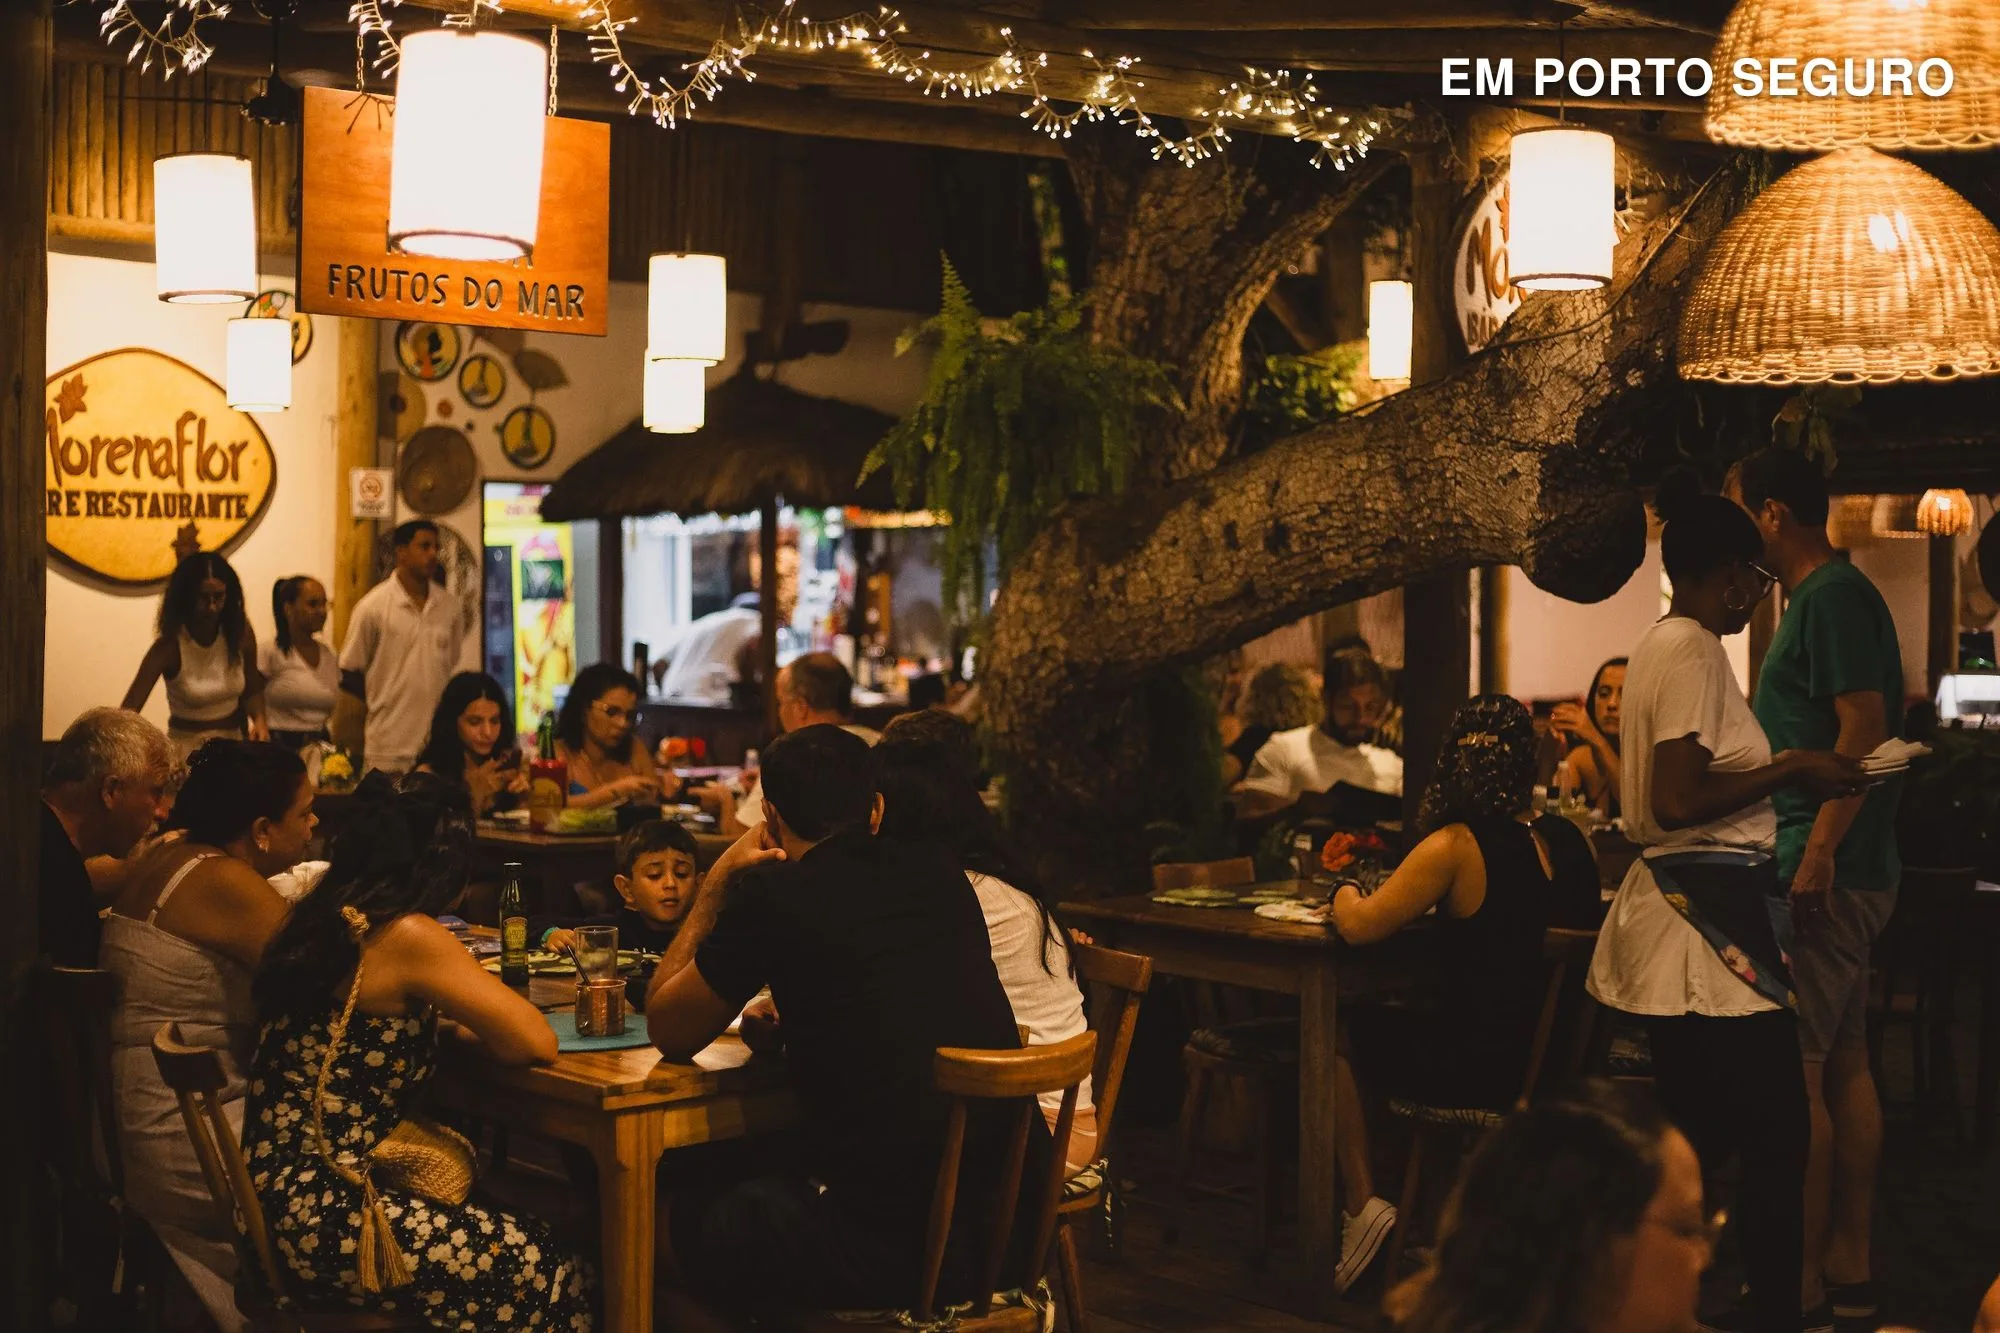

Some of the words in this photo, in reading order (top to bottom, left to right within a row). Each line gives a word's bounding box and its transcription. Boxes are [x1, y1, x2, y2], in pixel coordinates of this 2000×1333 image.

[328, 263, 450, 308] FRUTOS
[463, 276, 504, 311] DO
[518, 281, 585, 321] MAR
[65, 489, 81, 517] E
[85, 489, 249, 520] RESTAURANTE
